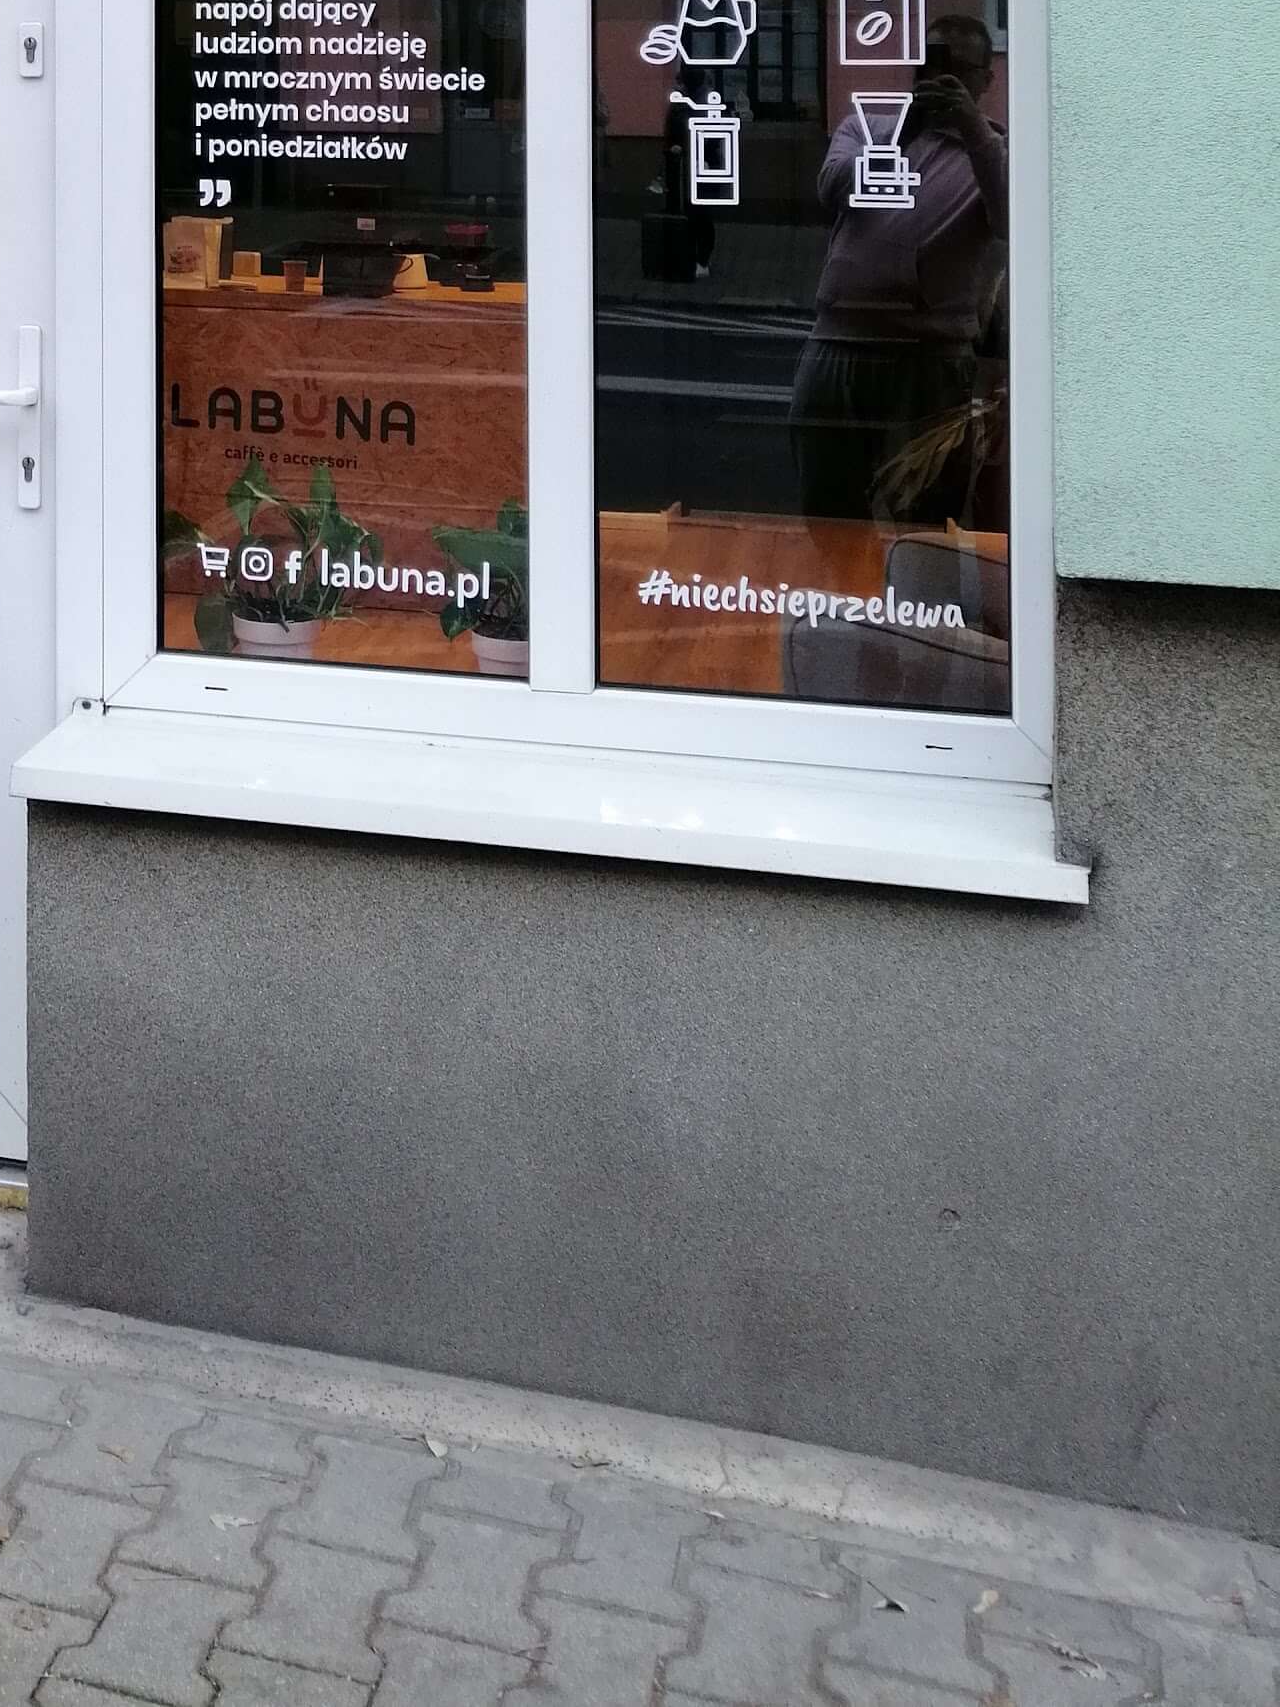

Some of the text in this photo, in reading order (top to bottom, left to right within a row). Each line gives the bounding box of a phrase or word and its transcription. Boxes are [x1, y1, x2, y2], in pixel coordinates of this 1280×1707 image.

[195, 30, 427, 62] ludziom nadzieję
[194, 66, 486, 97] w mrocznym świecie
[195, 98, 410, 128] pełnym chaosu
[195, 132, 408, 163] i poniedziałków
[224, 445, 358, 470] caffè e accessori
[320, 548, 490, 608] labuna.pl
[638, 569, 967, 629] #niechsieprzelewa
